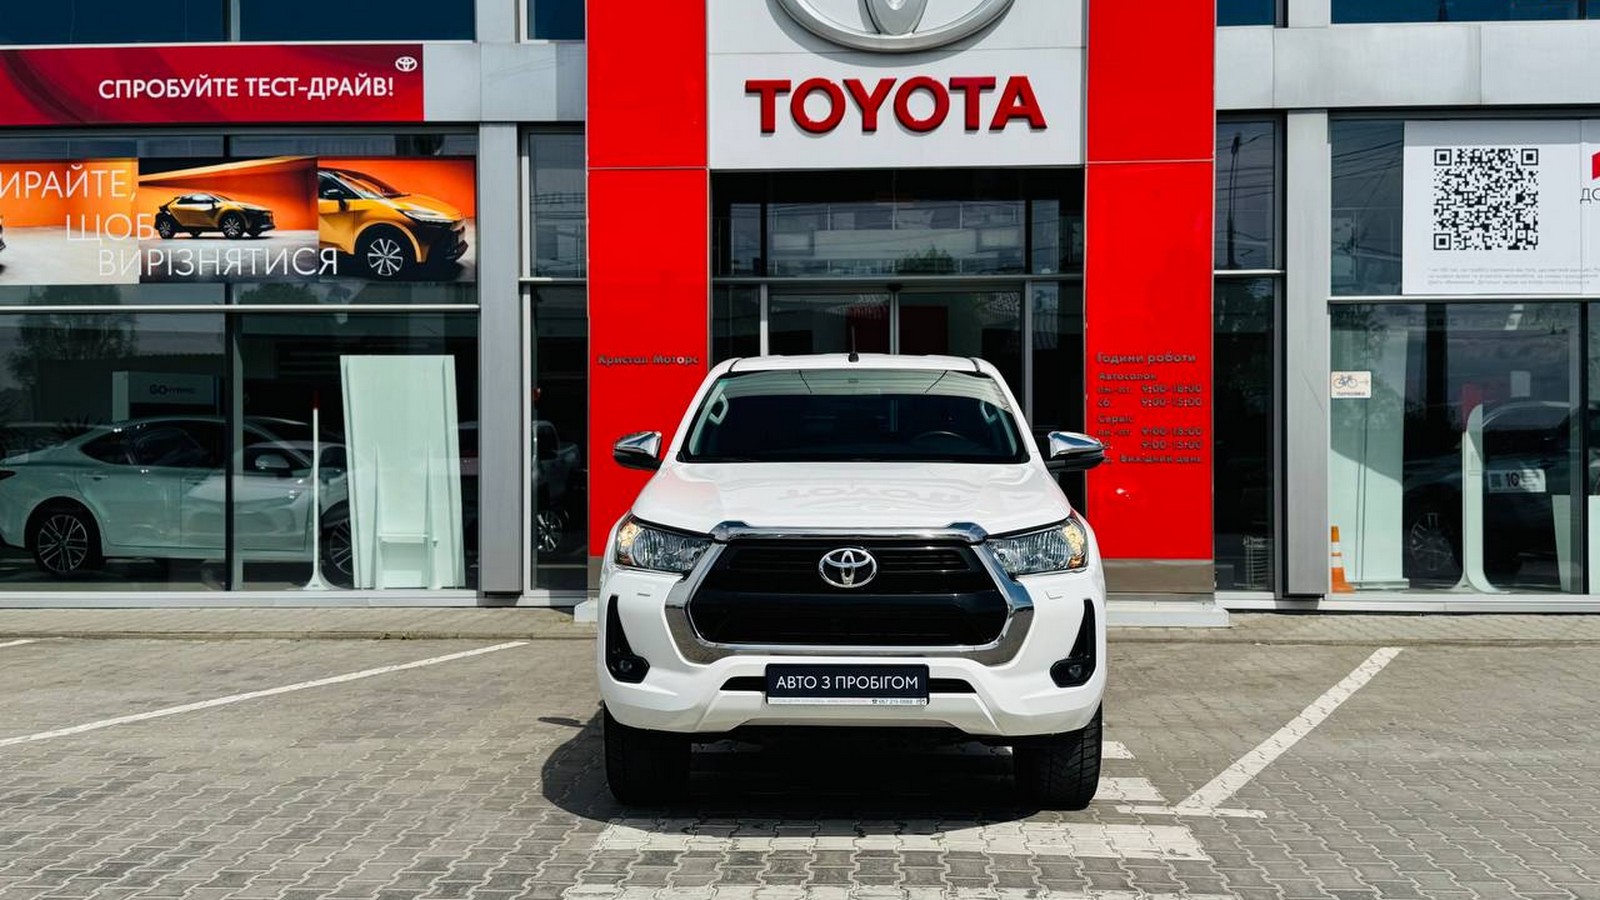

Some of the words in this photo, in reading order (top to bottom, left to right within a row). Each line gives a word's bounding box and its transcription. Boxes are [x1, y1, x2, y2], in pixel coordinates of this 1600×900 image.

[98, 74, 239, 99] СПРОБУЙТЕ
[245, 72, 394, 100] ТЕСТ-ДРАЙВ!
[745, 76, 1048, 134] TOYOTA
[66, 213, 155, 247] ЩОБ
[99, 248, 338, 276] ВИРІЗНЯТИСЯ
[653, 354, 699, 366] Моторс
[1097, 352, 1144, 364] Години
[1147, 351, 1196, 364] роботи
[775, 676, 818, 689] АВТО
[835, 676, 919, 689] ПРОБІГОМ
